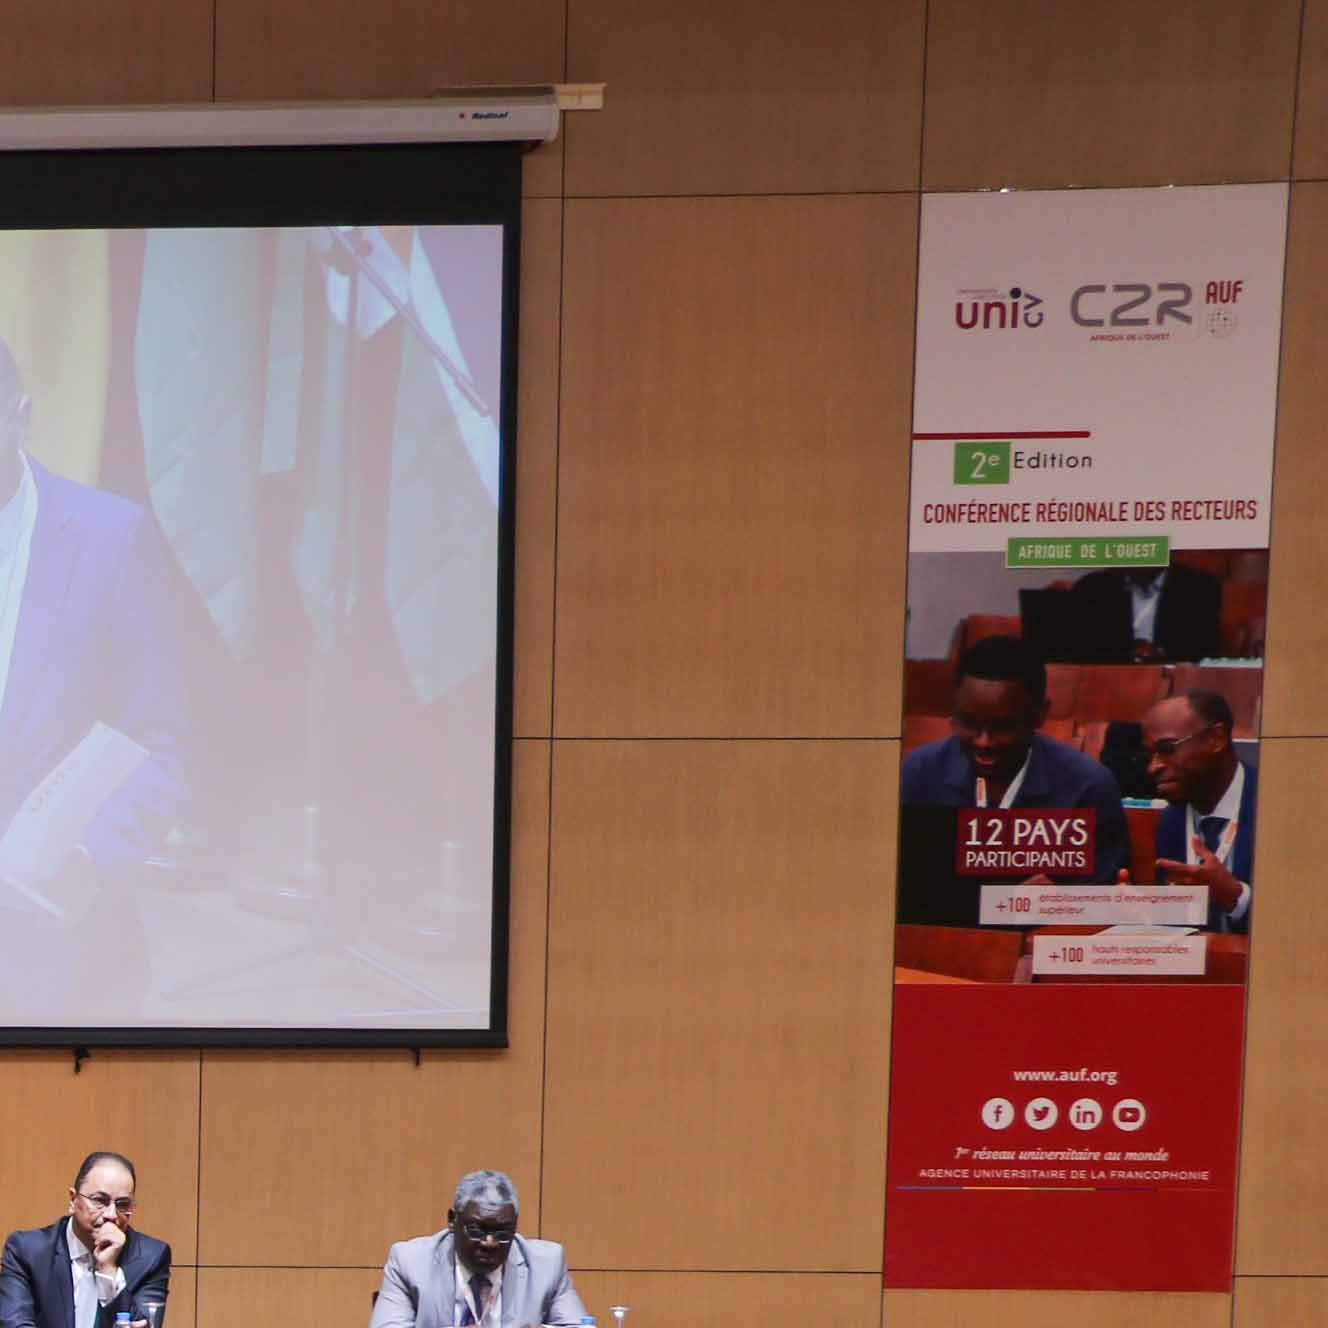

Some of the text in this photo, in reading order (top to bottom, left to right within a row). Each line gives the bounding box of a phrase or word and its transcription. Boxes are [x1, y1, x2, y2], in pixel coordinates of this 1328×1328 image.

[1205, 280, 1243, 305] AUF
[1013, 451, 1092, 469] Edition
[923, 497, 1258, 524] CONFÉRENCE RÉGIONALE DES RECTEURS
[1018, 542, 1157, 560] AFRIQUE DE L'OUEST
[965, 818, 1088, 847] 12 PAYS
[965, 851, 1086, 868] PARTICIPANTS
[996, 897, 1031, 913] +100
[1049, 947, 1084, 963] +100
[1013, 1067, 1119, 1086] www.auf.org
[972, 1147, 1015, 1161] réseau
[1018, 1147, 1100, 1162] universitaire
[1104, 1151, 1121, 1162] au
[1124, 1147, 1169, 1162] monde
[919, 1168, 1209, 1181] AGENCE UNIVERSITAIRE DE LA FRANCOPHONIE
